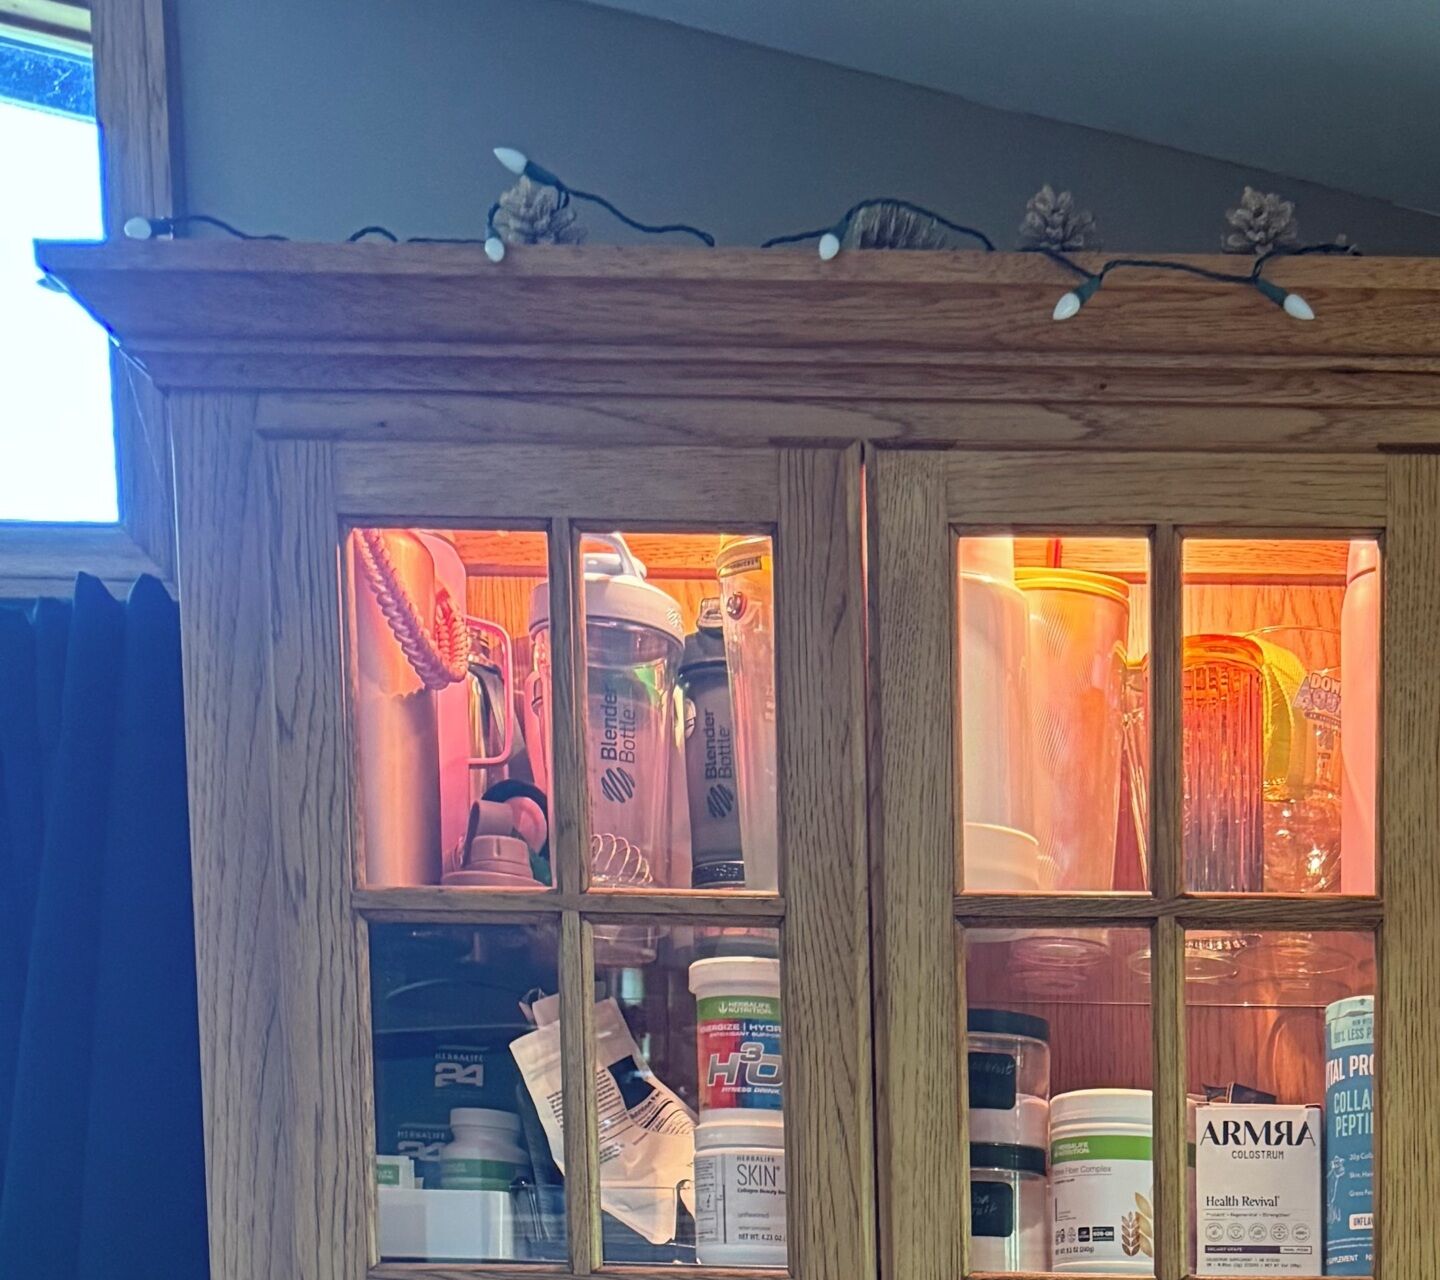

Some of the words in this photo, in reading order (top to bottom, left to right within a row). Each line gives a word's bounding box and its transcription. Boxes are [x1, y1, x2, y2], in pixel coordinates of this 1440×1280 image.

[600, 685, 618, 762] Blender
[619, 710, 636, 764] Bottle
[704, 709, 716, 780] Blender
[718, 724, 732, 779] Bottle
[1347, 1027, 1364, 1042] LESS
[1325, 1056, 1346, 1092] ITAL
[1333, 1088, 1374, 1115] COLLA
[736, 1154, 775, 1163] HERBALIFE
[1231, 1150, 1285, 1160] COLOSTRUM
[1080, 1164, 1112, 1176] Complex
[1205, 1195, 1239, 1207] Health
[1241, 1195, 1279, 1207] Revival
[738, 1233, 749, 1241] NET
